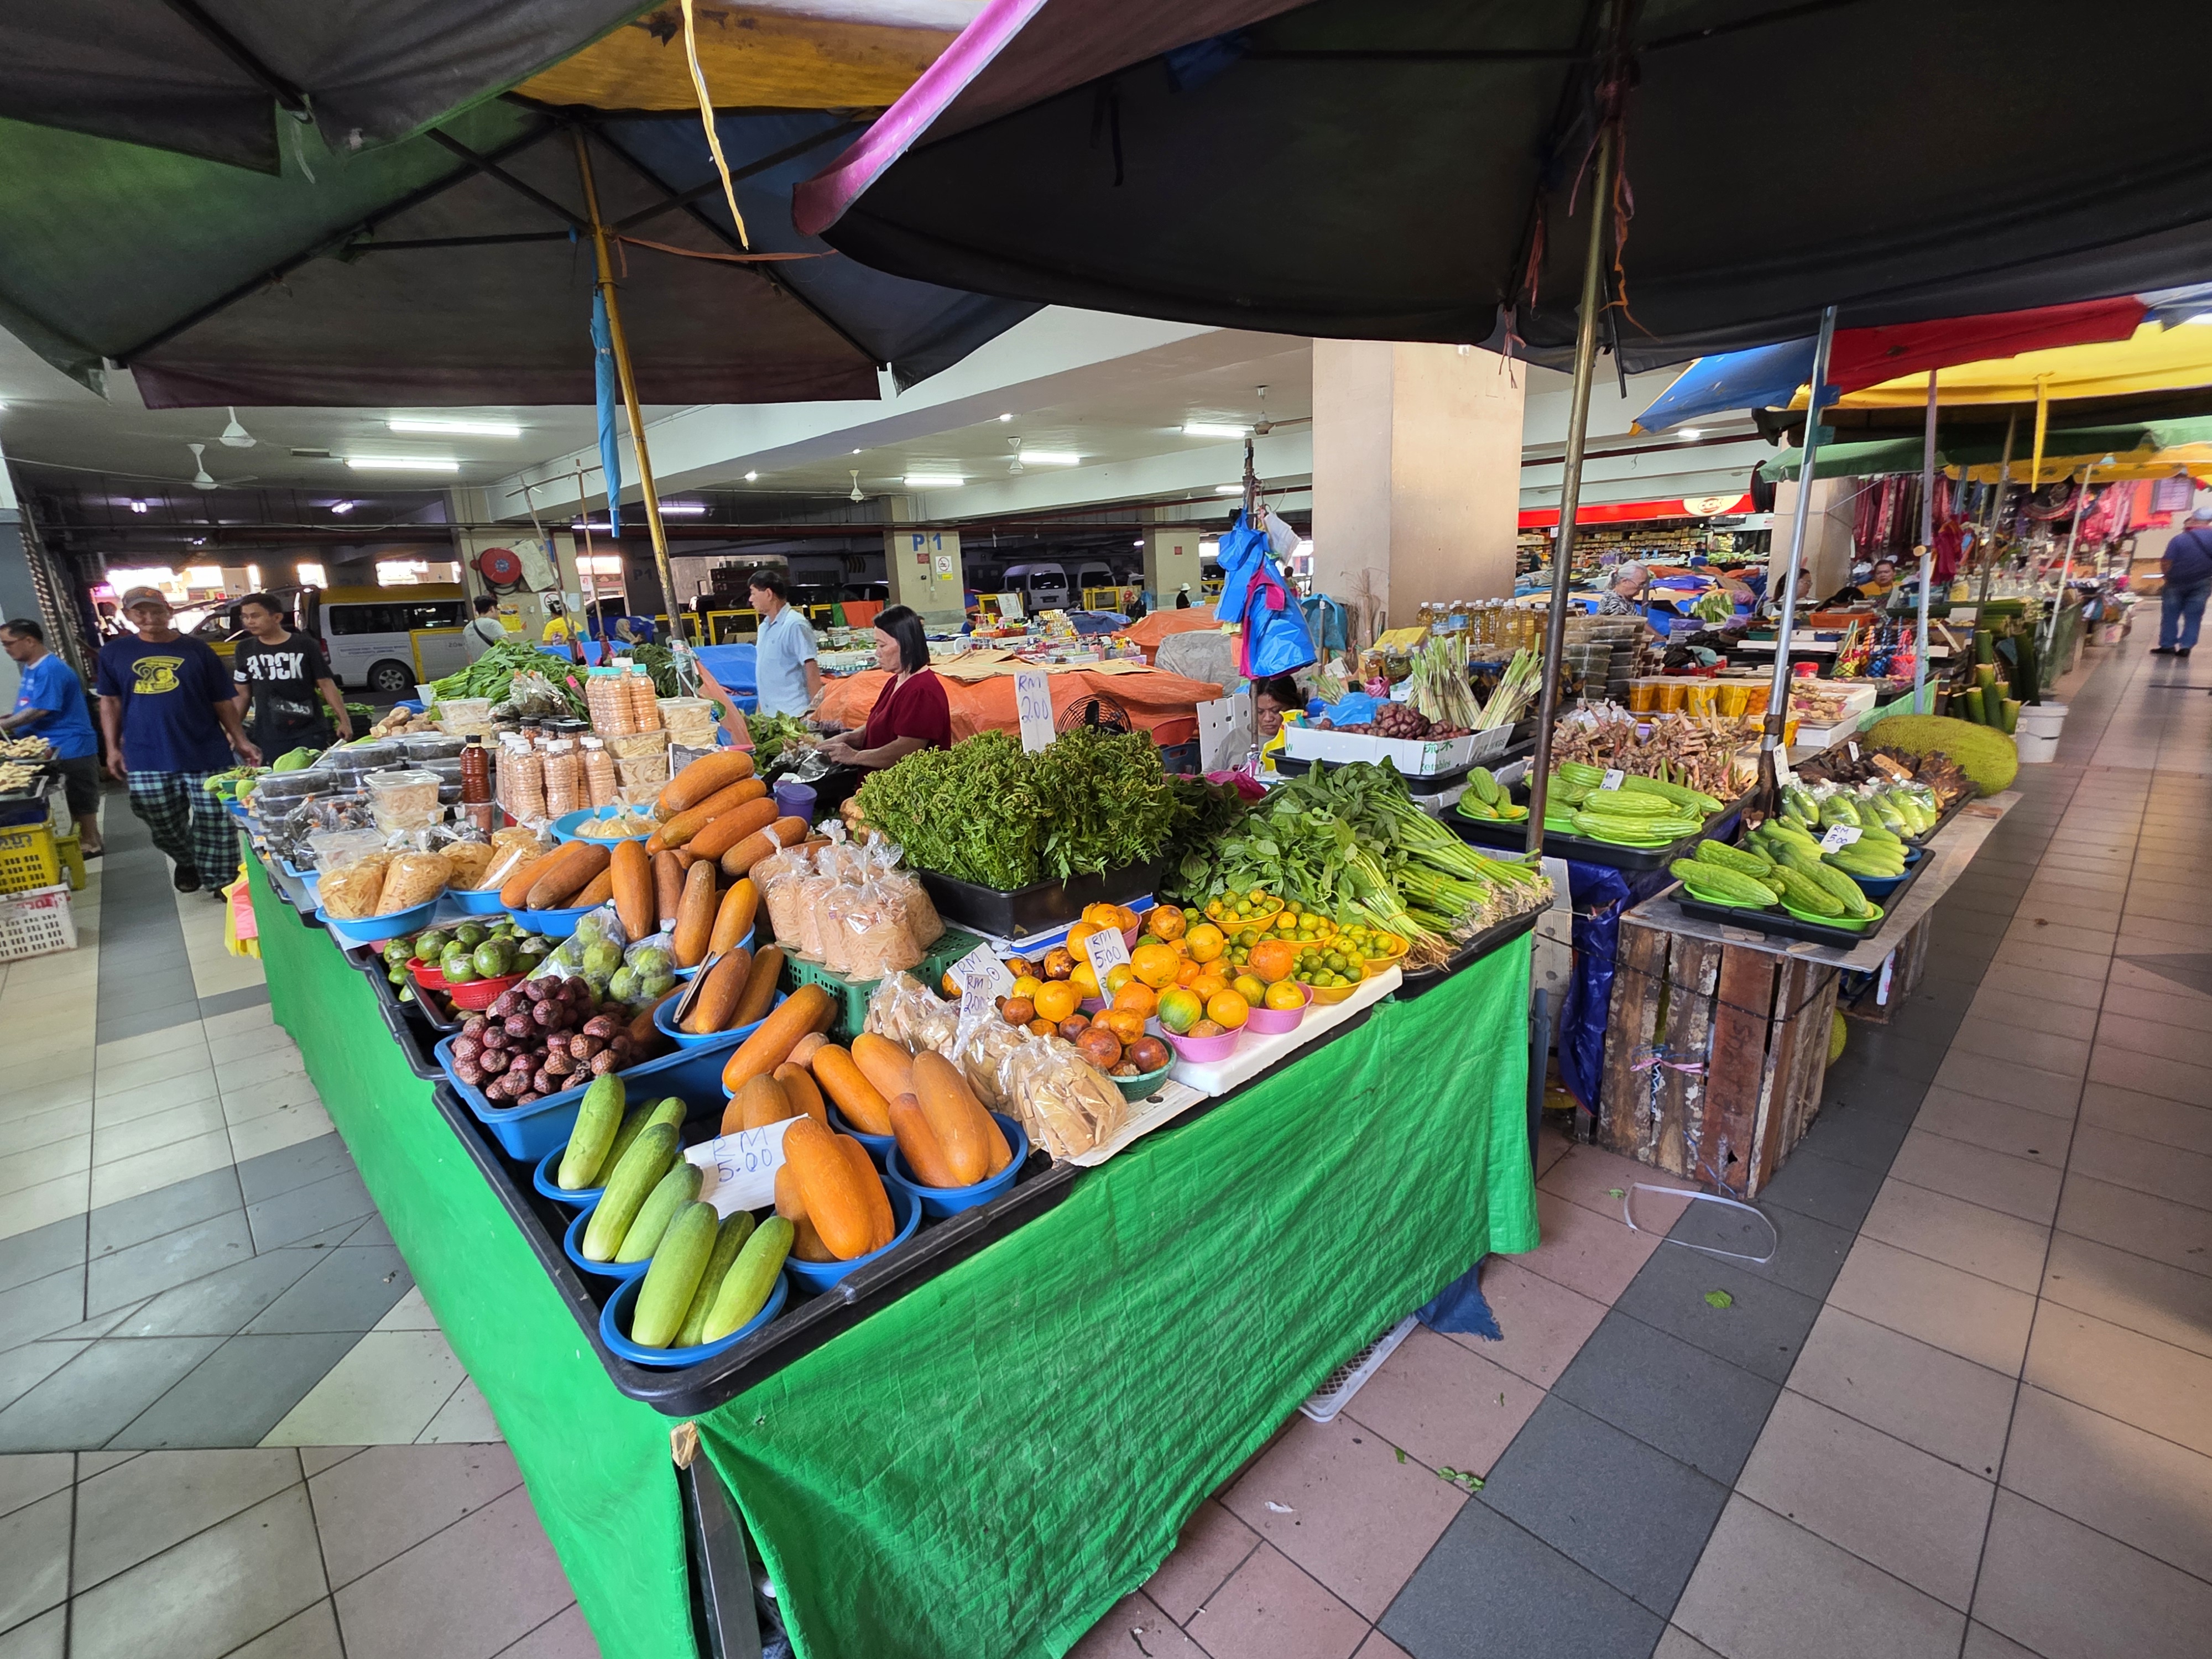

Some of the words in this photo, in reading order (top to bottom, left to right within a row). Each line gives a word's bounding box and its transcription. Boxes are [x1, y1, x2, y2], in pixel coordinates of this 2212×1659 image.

[1698, 499, 1724, 510] CCK
[633, 568, 653, 581] P1
[247, 653, 304, 680] ROCK
[1019, 675, 1041, 692] RM
[1021, 696, 1048, 723] 2.00
[1833, 826, 1849, 834] RM
[1092, 930, 1111, 947] RM
[957, 951, 982, 975] RM
[967, 975, 984, 990] RM
[712, 1126, 768, 1161] RM
[717, 1149, 773, 1182] 5.00
